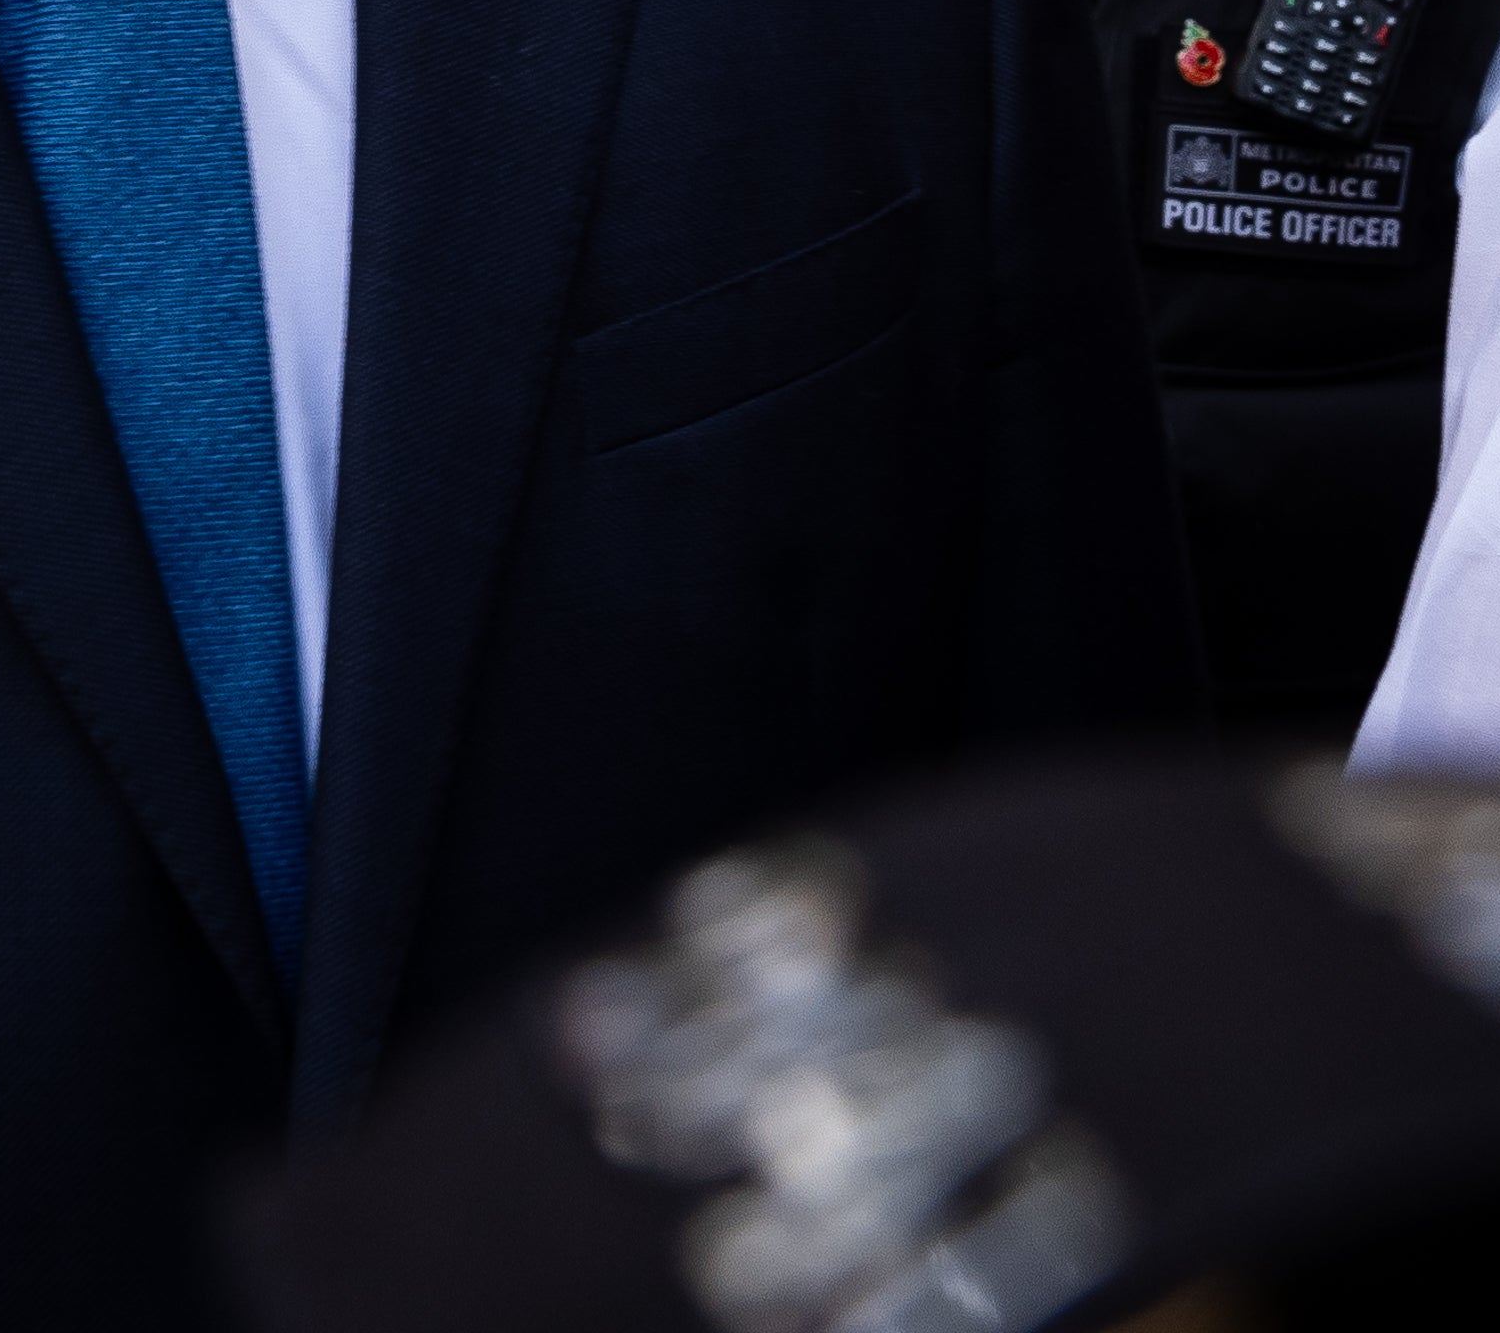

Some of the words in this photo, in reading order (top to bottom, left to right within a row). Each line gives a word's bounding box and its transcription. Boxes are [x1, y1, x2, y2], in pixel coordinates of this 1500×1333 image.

[1260, 168, 1378, 199] POLICE
[1162, 198, 1273, 239] POLICE
[1281, 210, 1400, 248] OFFICER
